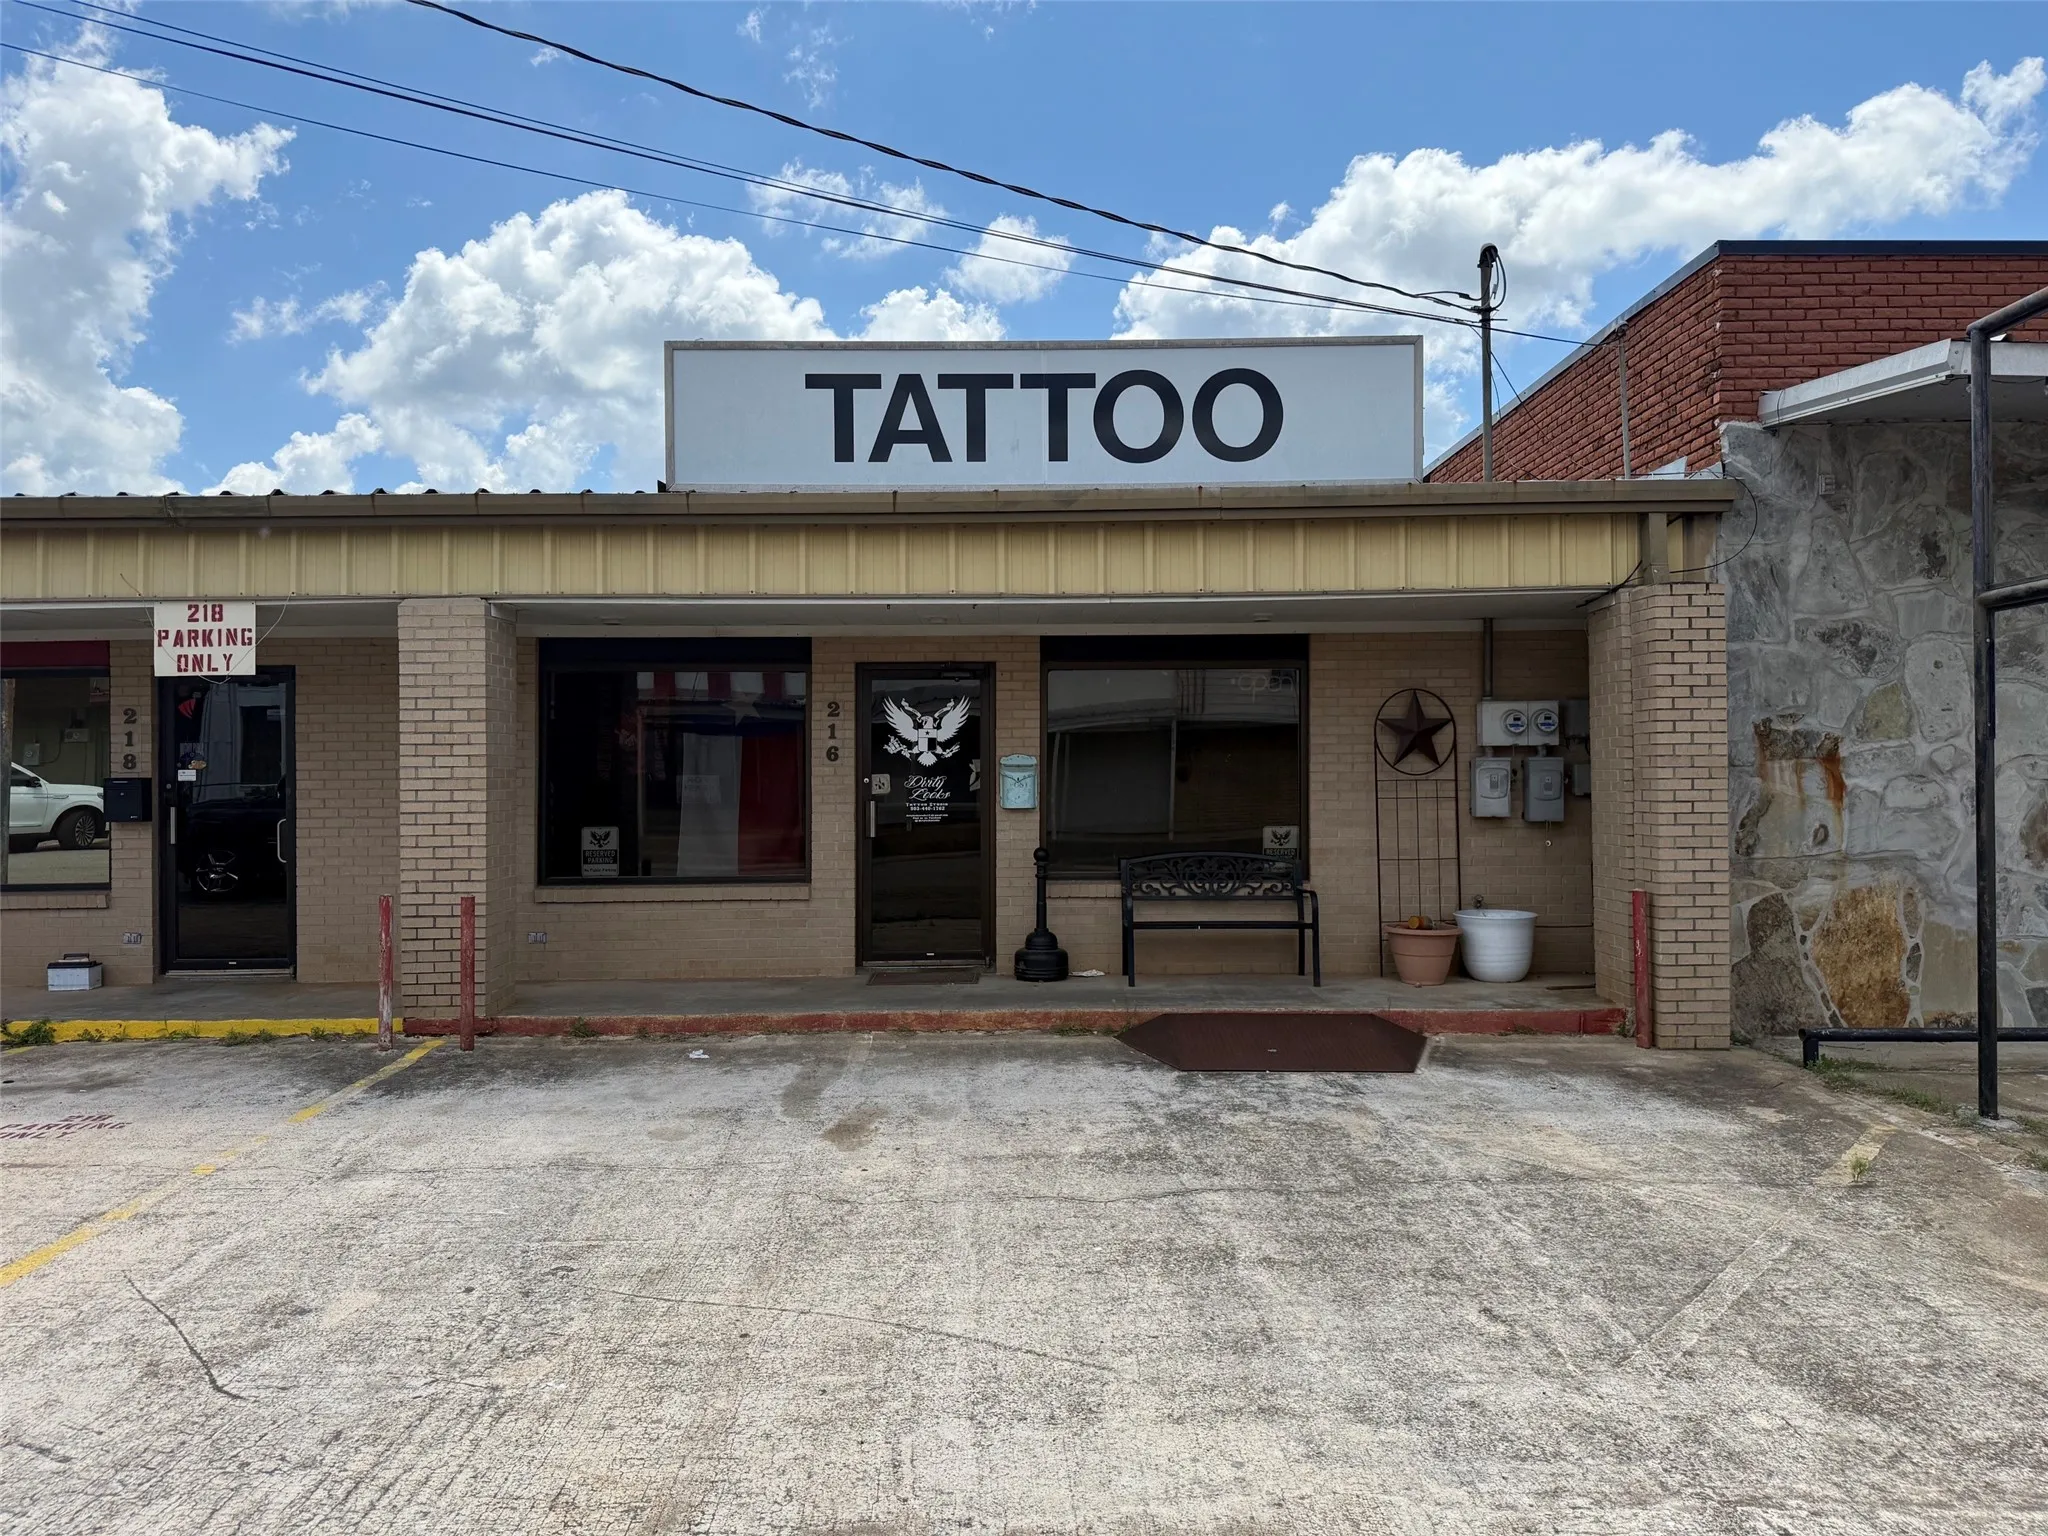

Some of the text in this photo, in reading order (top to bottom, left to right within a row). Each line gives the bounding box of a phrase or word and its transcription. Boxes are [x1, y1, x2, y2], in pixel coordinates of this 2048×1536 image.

[805, 367, 1284, 463] TATTOO
[187, 603, 224, 623] 218
[157, 627, 254, 647] PARKING
[176, 653, 234, 674] ONLY
[122, 707, 137, 770] 218
[825, 701, 840, 762] 216
[903, 774, 948, 792] Dirty
[908, 787, 951, 802] Looks
